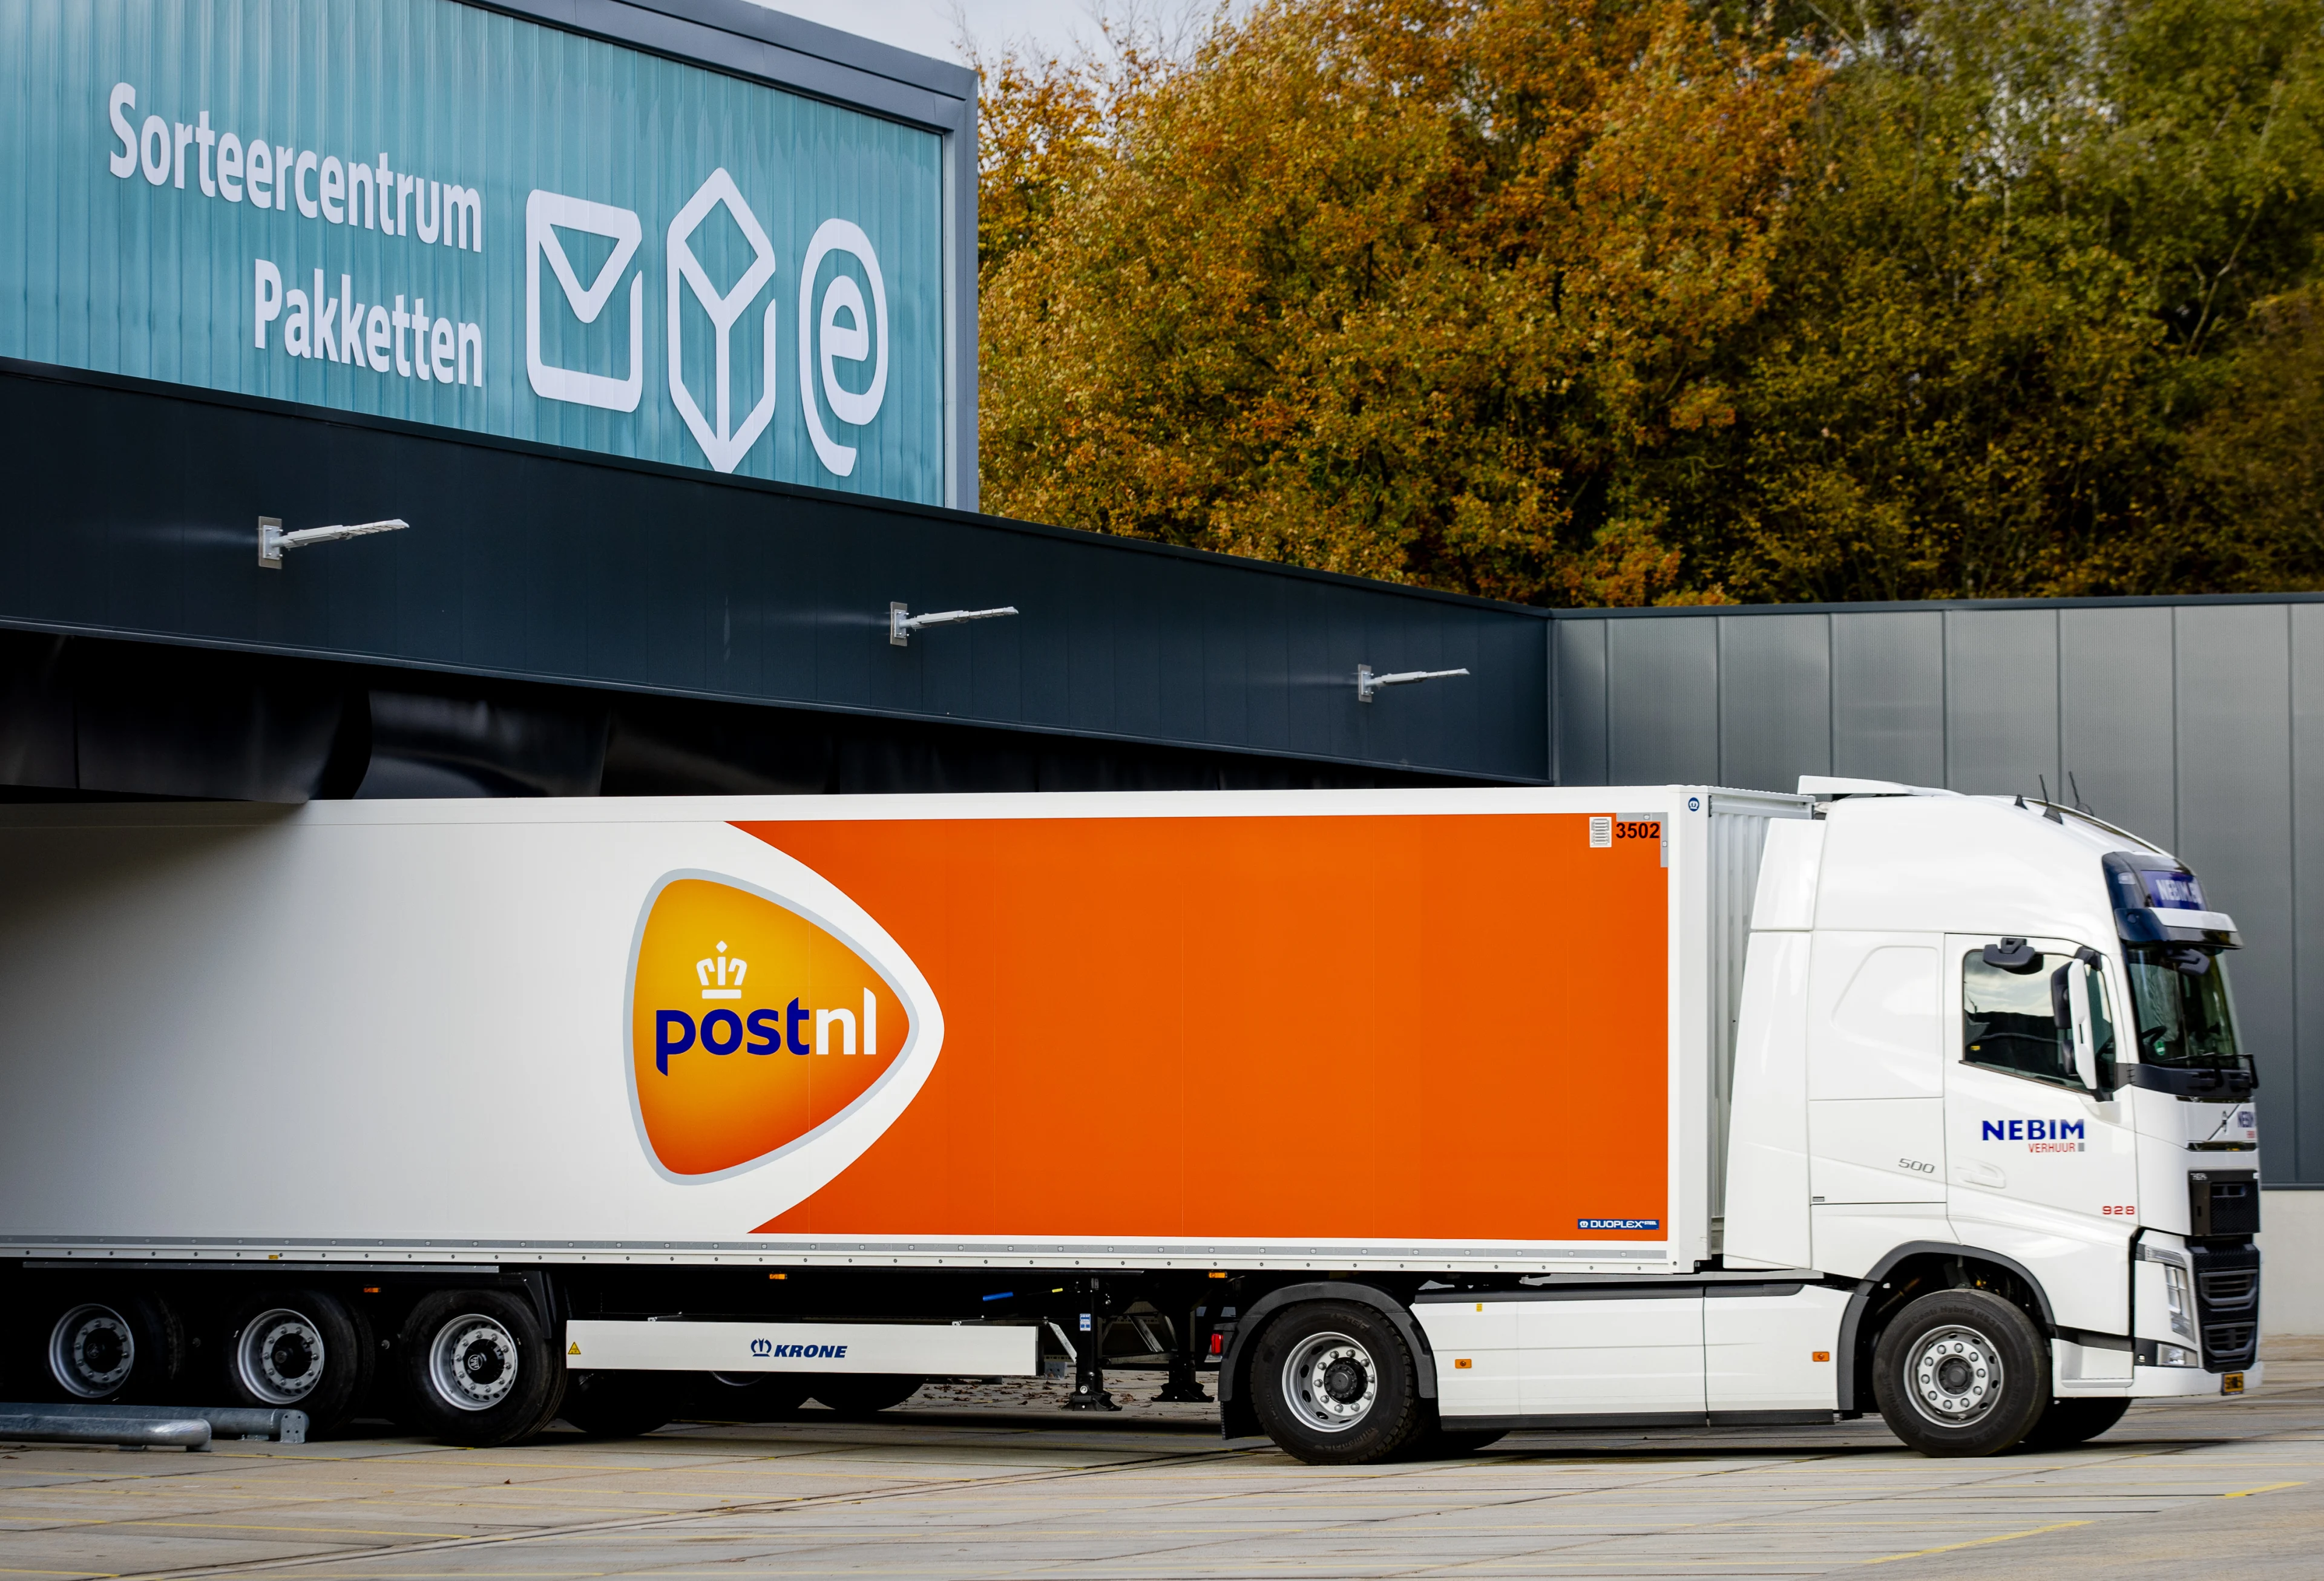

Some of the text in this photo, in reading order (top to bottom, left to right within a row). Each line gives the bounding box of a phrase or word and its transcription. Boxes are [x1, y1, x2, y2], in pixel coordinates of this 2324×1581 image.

[109, 82, 482, 253] Sorteercentrum
[255, 258, 482, 387] Pakketten
[1615, 822, 1660, 839] 3502
[656, 987, 876, 1076] postnl
[1982, 1119, 2084, 1141] NEBIM
[2028, 1142, 2076, 1153] VERHUUR
[1898, 1158, 1935, 1173] 500
[2102, 1206, 2135, 1215] 928
[773, 1344, 848, 1358] KRONE
